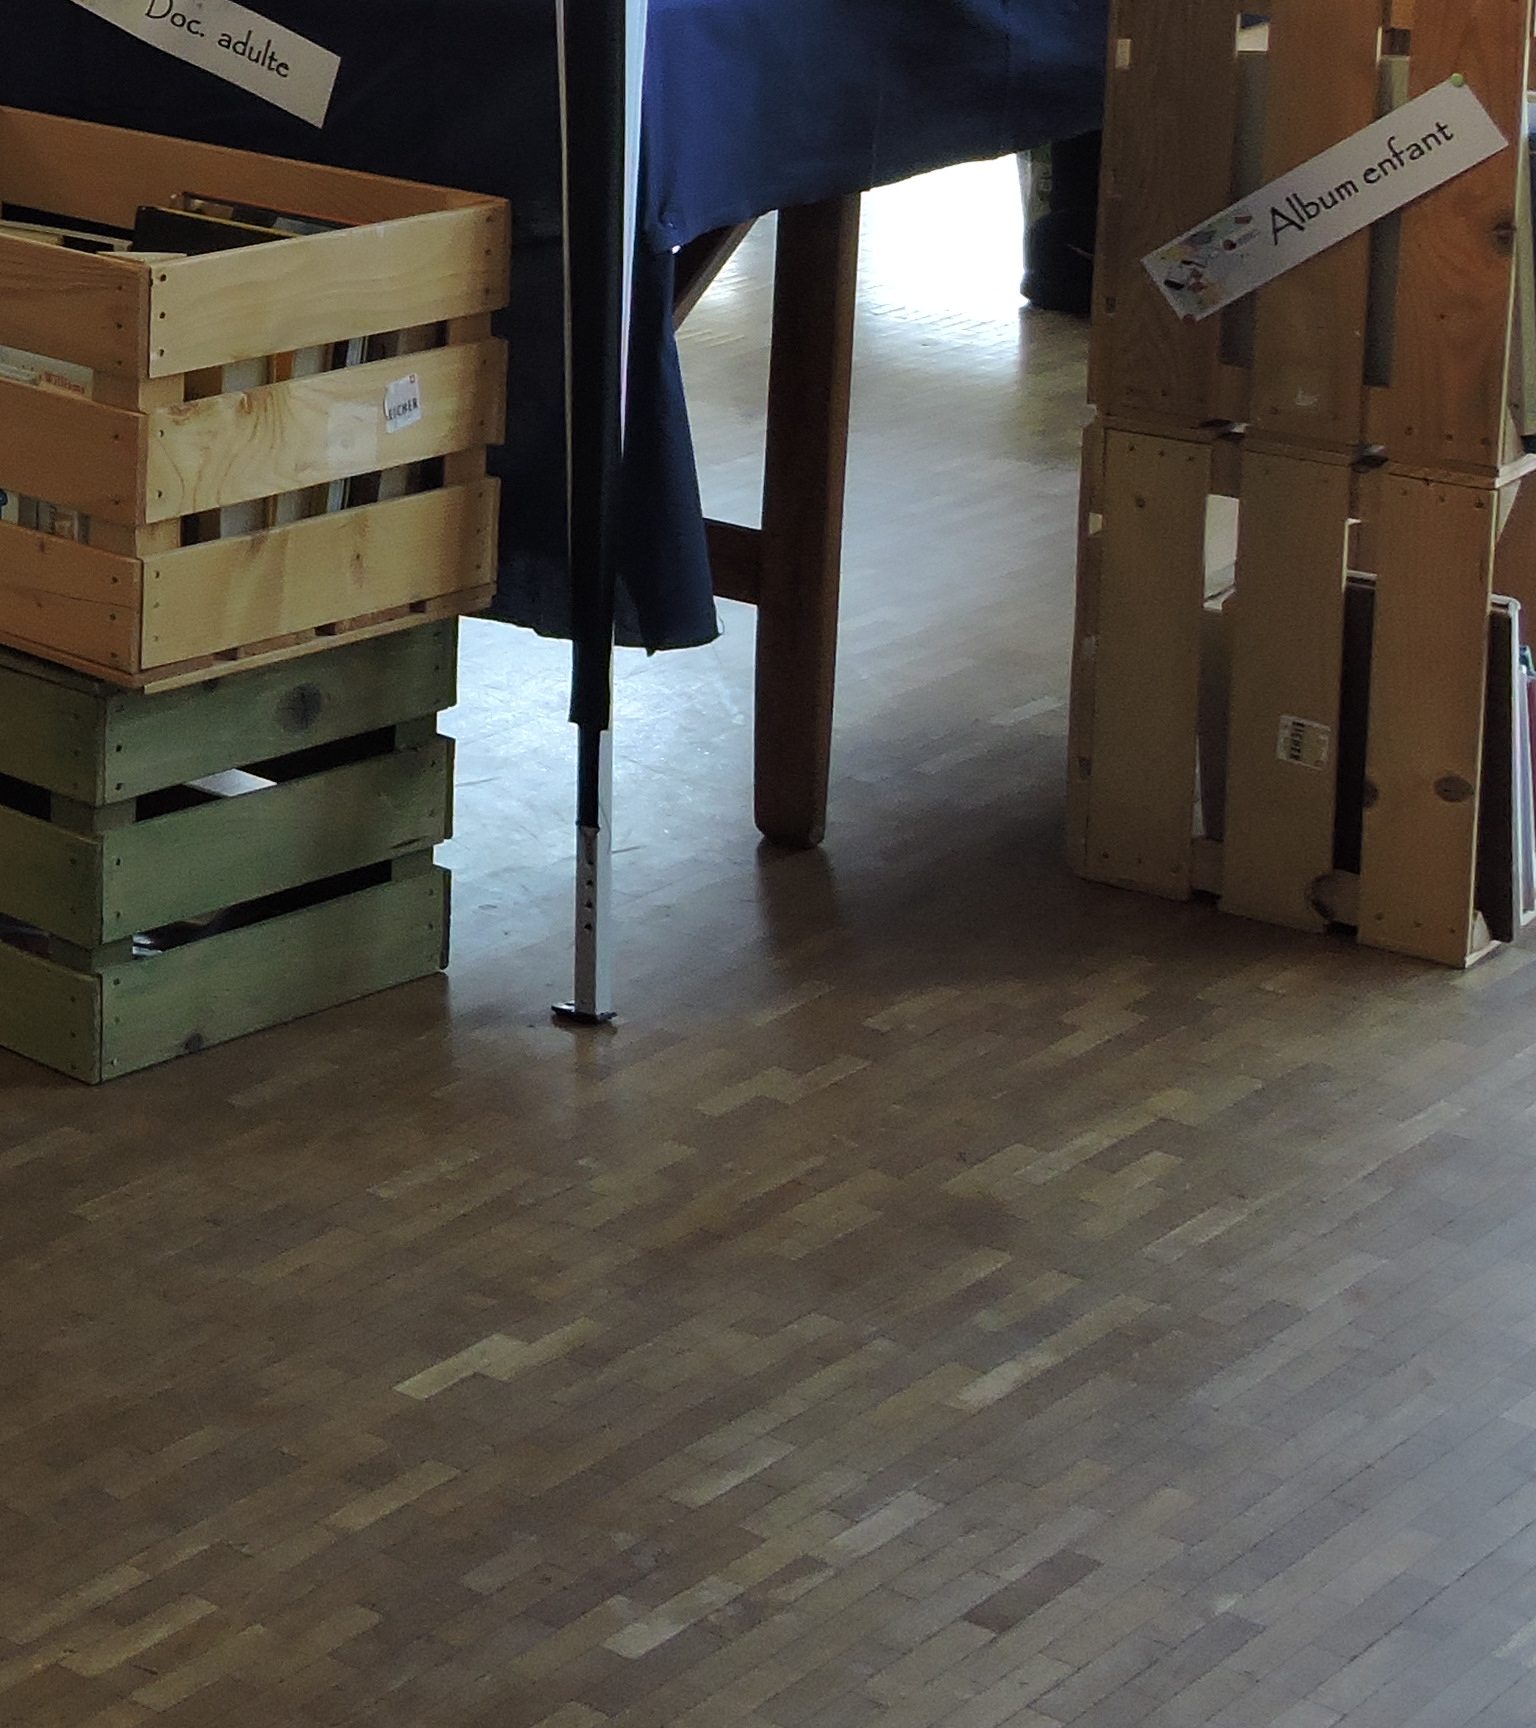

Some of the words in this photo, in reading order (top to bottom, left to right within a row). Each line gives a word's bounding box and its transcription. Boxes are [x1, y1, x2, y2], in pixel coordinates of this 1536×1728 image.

[217, 29, 291, 80] adulte
[1269, 191, 1360, 246] Album
[1362, 120, 1456, 187] enfant
